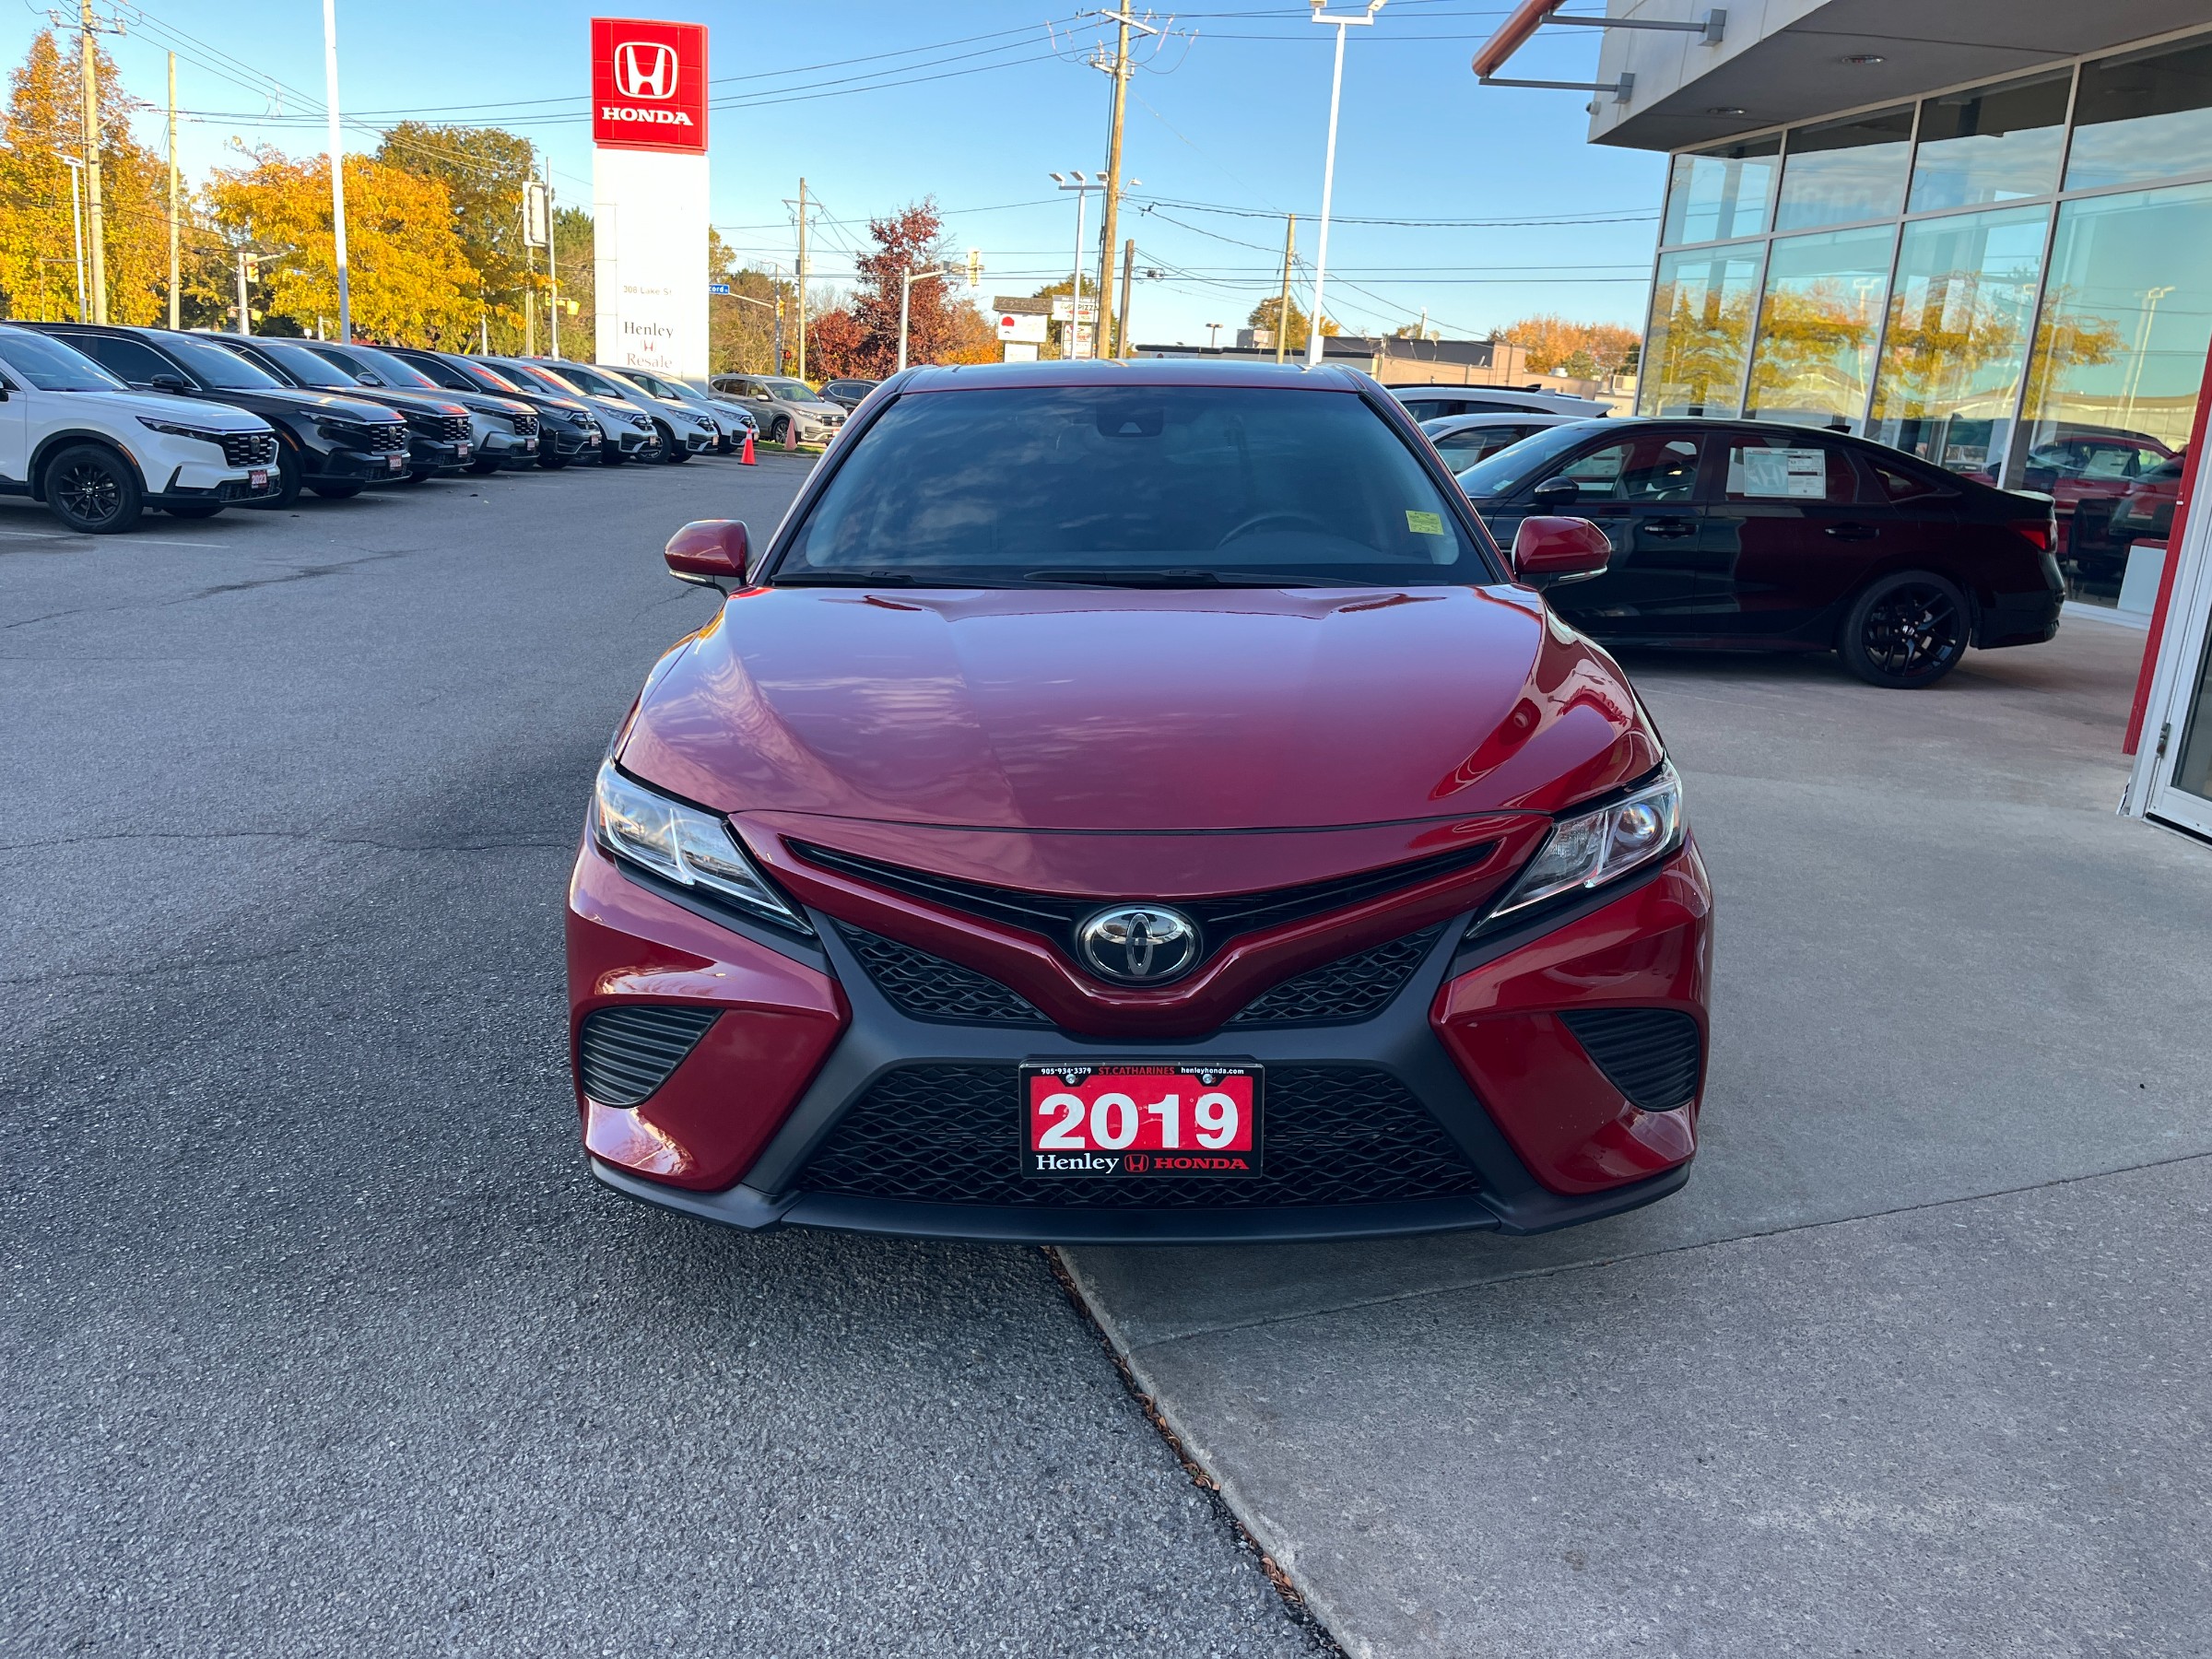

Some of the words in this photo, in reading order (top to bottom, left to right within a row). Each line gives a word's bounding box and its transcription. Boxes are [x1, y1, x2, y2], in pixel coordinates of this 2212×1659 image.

[602, 106, 694, 126] HONDA
[640, 287, 660, 295] Lake
[624, 321, 674, 338] Henley
[627, 352, 673, 369] Resale
[252, 474, 267, 485] 2023
[1181, 1066, 1244, 1076] henleyhonda.com
[1038, 1092, 1239, 1150] 2019
[1036, 1153, 1119, 1173] Henley
[1154, 1158, 1250, 1170] HONDA
